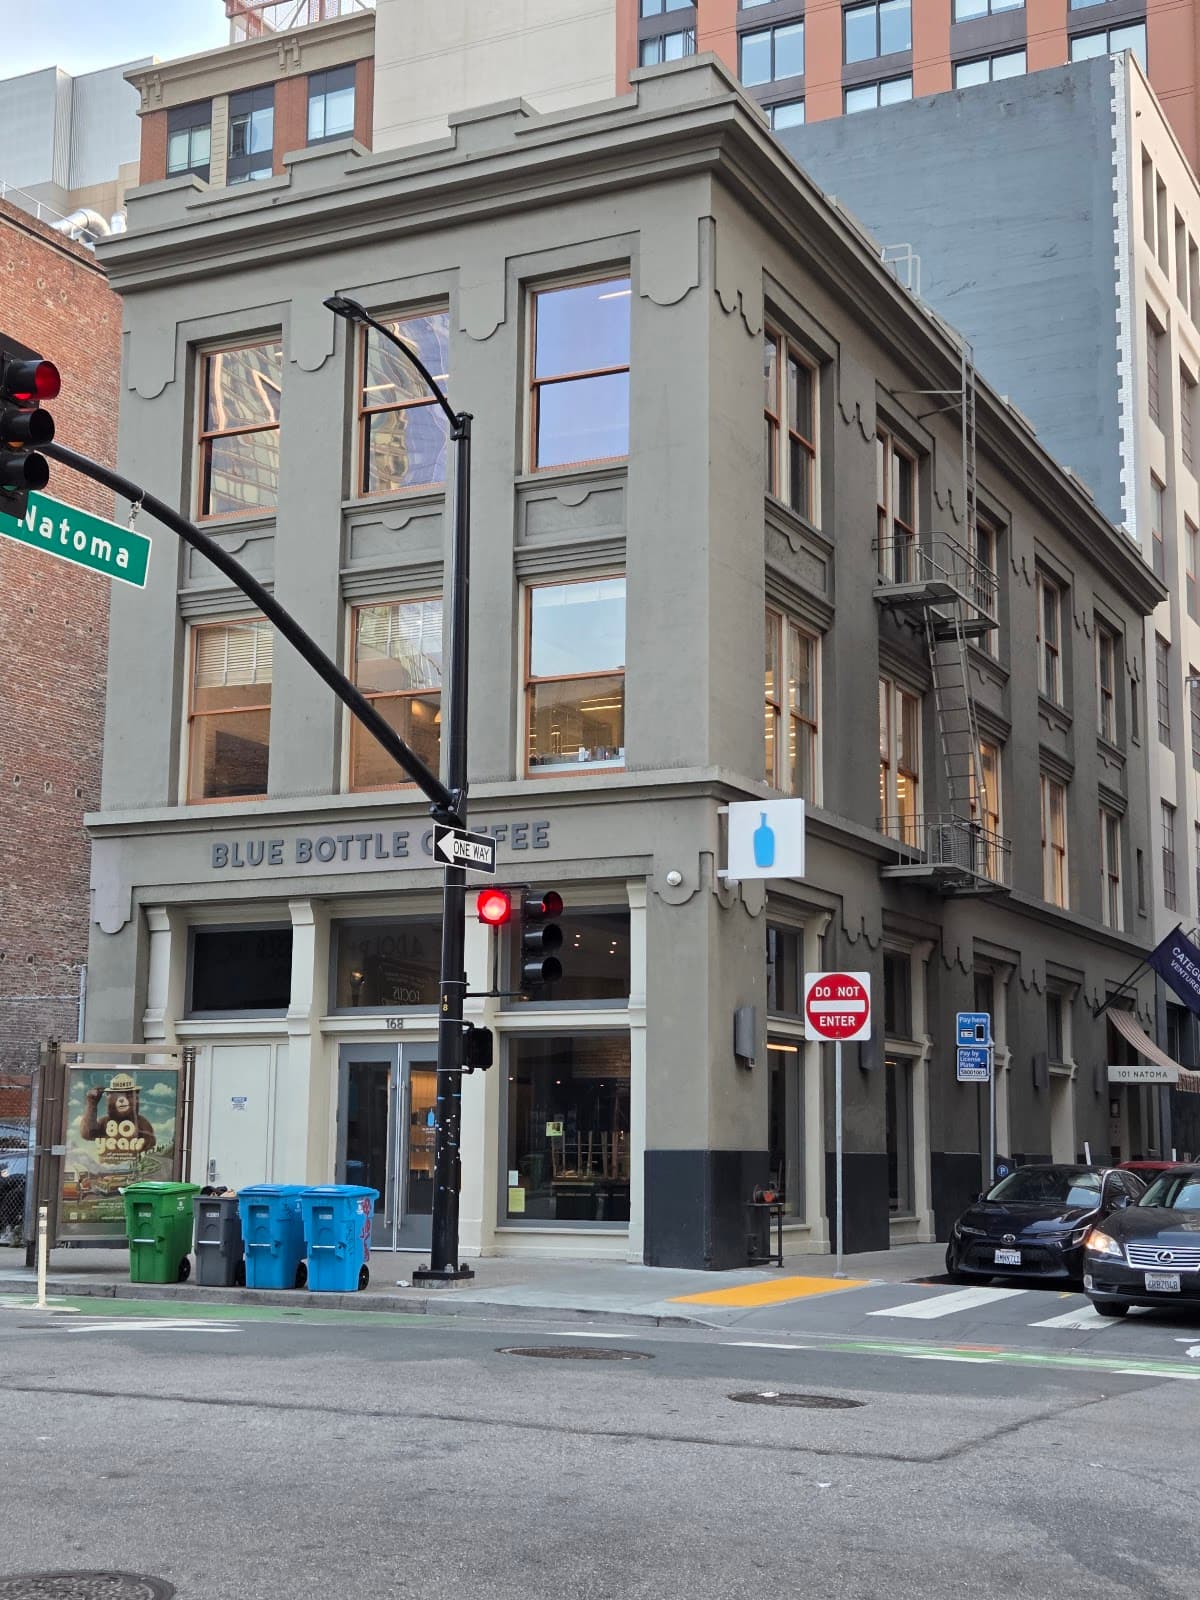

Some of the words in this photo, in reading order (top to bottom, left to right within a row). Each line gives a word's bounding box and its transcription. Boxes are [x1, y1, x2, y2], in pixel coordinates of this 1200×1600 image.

[17, 505, 129, 568] Natoma
[212, 839, 284, 868] BLUE
[296, 831, 409, 863] BOTTLE
[420, 821, 550, 856] CFEE
[453, 841, 470, 857] ONE
[473, 845, 490, 862] WAY
[815, 987, 831, 998] DO
[837, 986, 860, 997] NOT
[386, 1018, 404, 1029] 168
[819, 1016, 856, 1027] ENTER
[959, 1016, 971, 1024] Pay
[960, 1050, 971, 1058] Pay
[972, 1050, 979, 1058] by
[1133, 1070, 1168, 1078] NATOMA
[106, 1119, 136, 1138] 80
[95, 1137, 145, 1154] years
